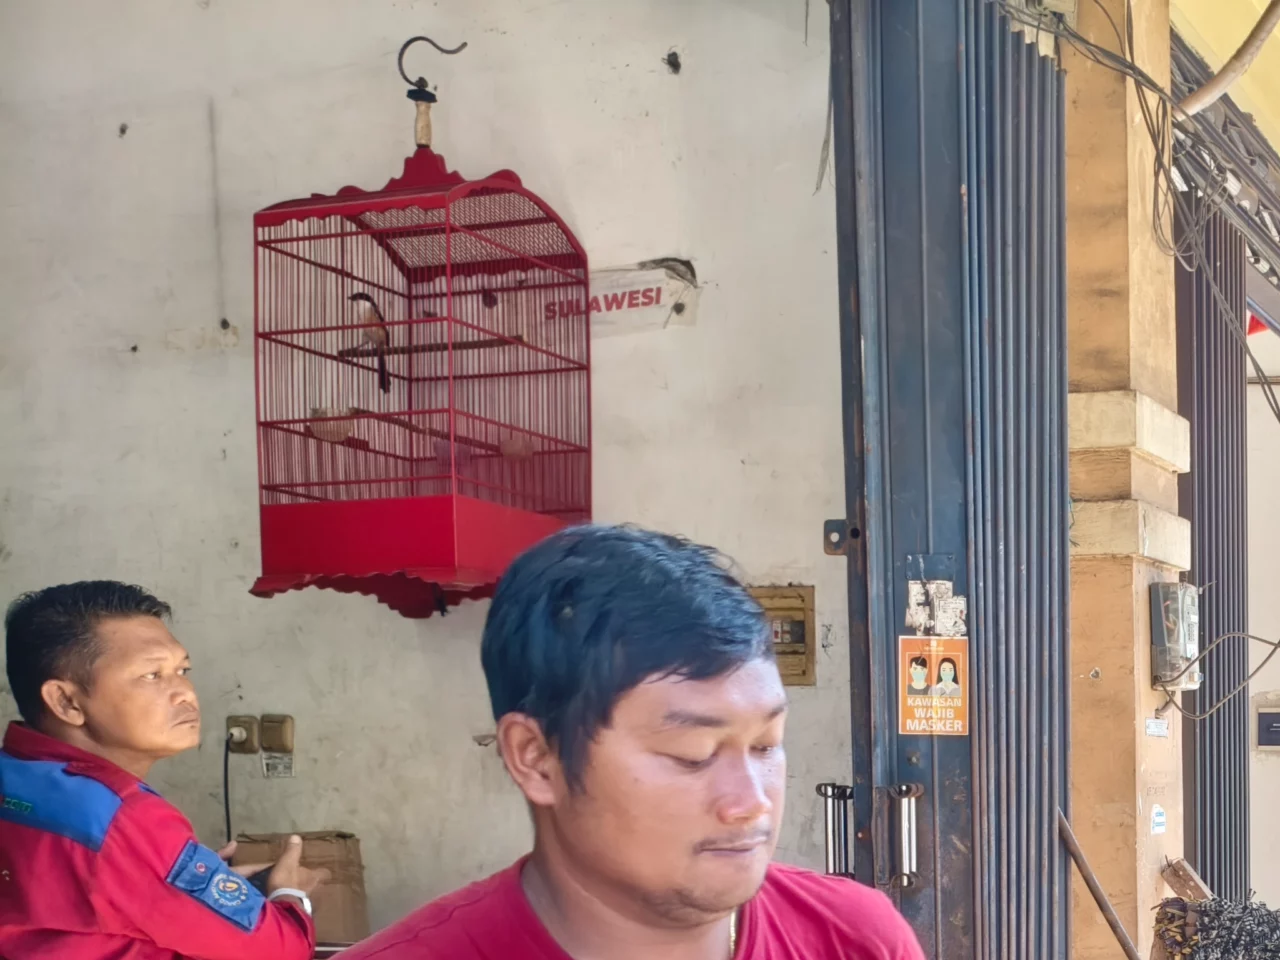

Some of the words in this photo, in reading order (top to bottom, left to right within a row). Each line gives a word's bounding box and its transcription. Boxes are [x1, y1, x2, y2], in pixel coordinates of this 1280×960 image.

[545, 287, 662, 321] SULAWESI
[907, 697, 962, 707] KAWASAN
[914, 708, 955, 718] WAJIB
[906, 719, 963, 731] MASKER
